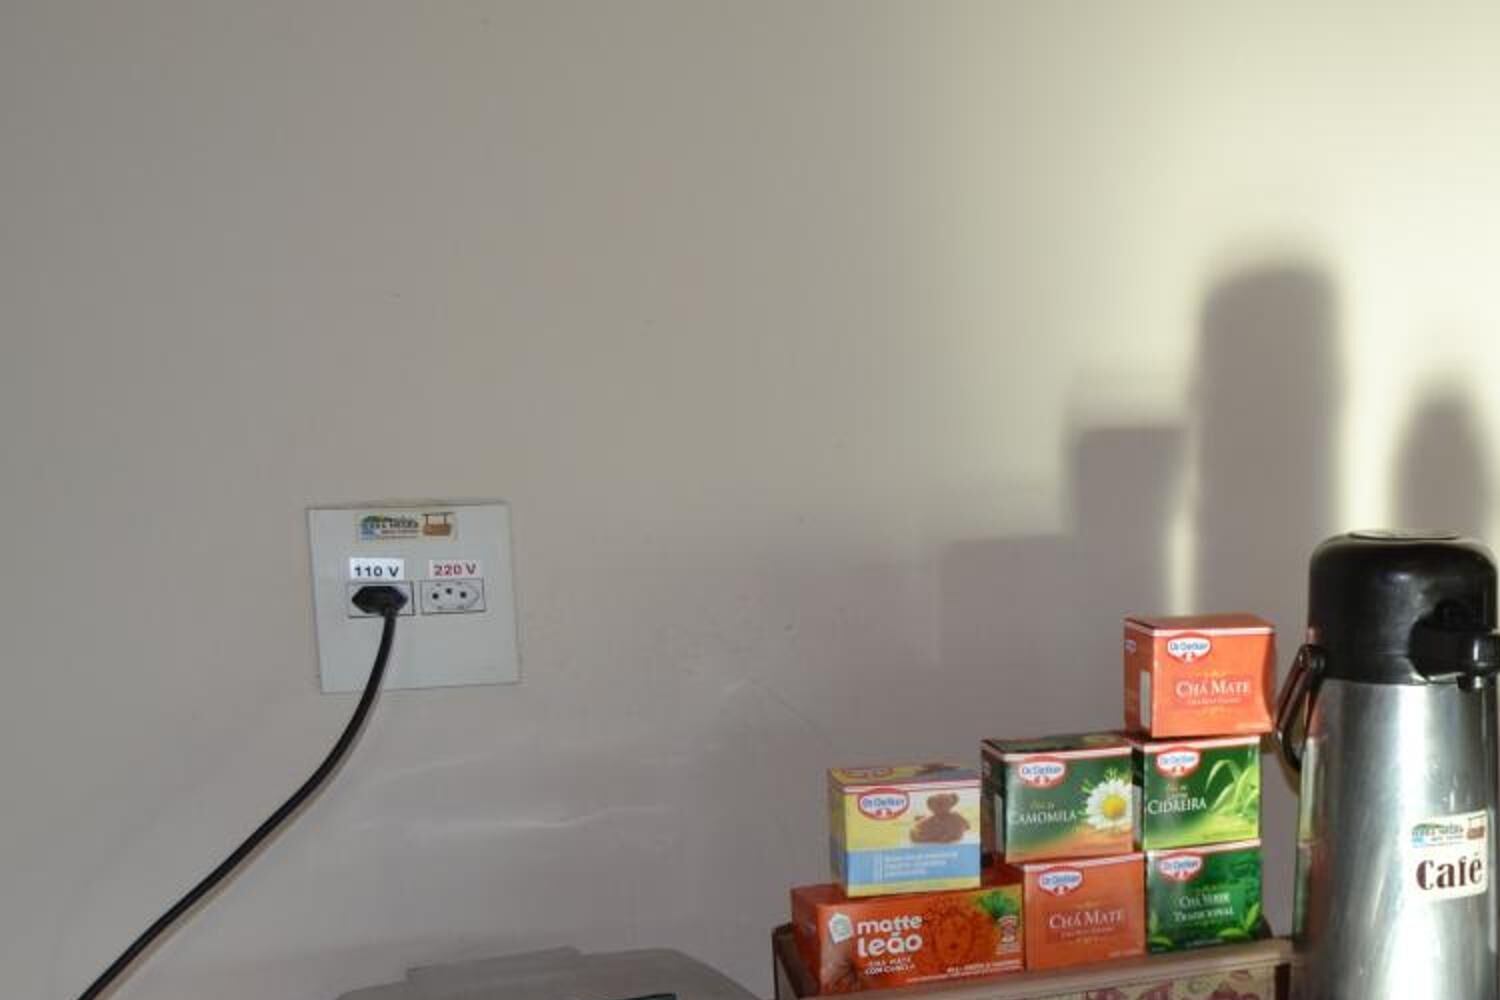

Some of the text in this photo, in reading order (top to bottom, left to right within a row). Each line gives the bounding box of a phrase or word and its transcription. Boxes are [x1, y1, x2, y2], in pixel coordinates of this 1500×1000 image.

[354, 566, 399, 577] 110 V
[433, 563, 477, 577] 220 V
[1416, 851, 1483, 891] Café
[857, 914, 923, 935] matte
[857, 931, 923, 957] leão
